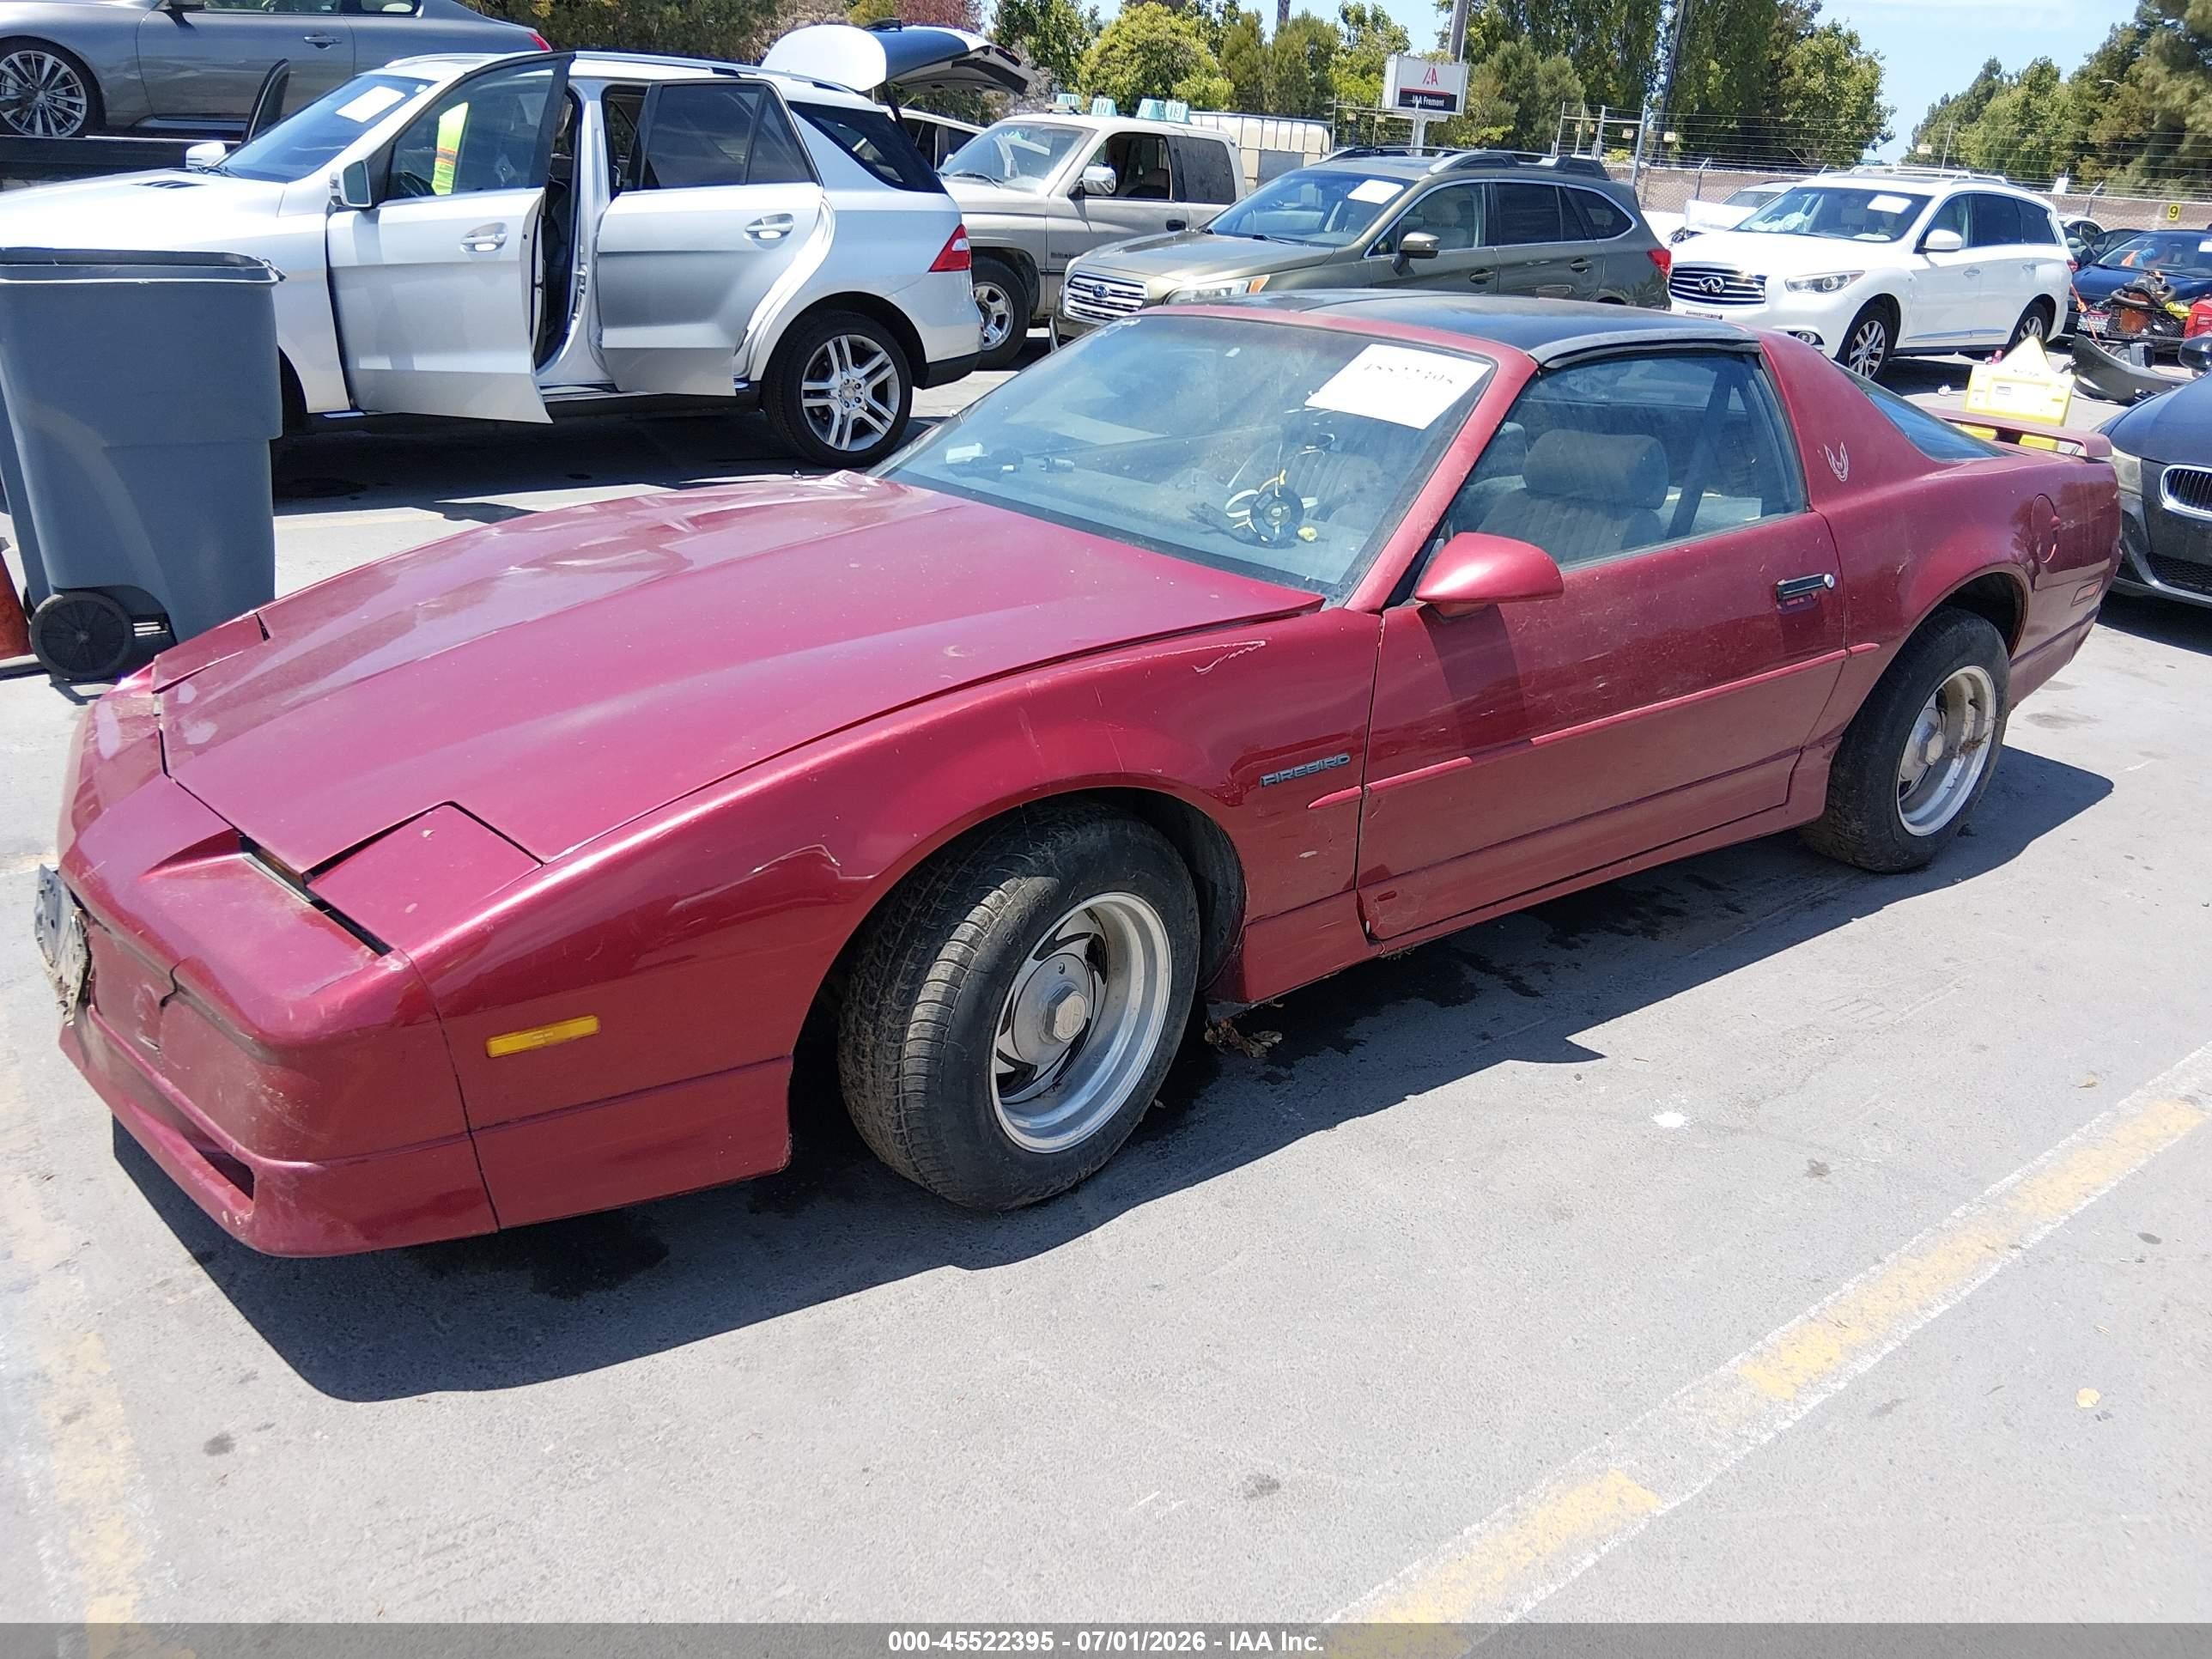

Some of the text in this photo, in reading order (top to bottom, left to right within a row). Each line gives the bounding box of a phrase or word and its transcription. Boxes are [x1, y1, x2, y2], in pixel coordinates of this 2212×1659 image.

[1423, 95, 1444, 107] Fremont
[2169, 205, 2179, 219] 9
[1261, 752, 1351, 787] FIREBIRD
